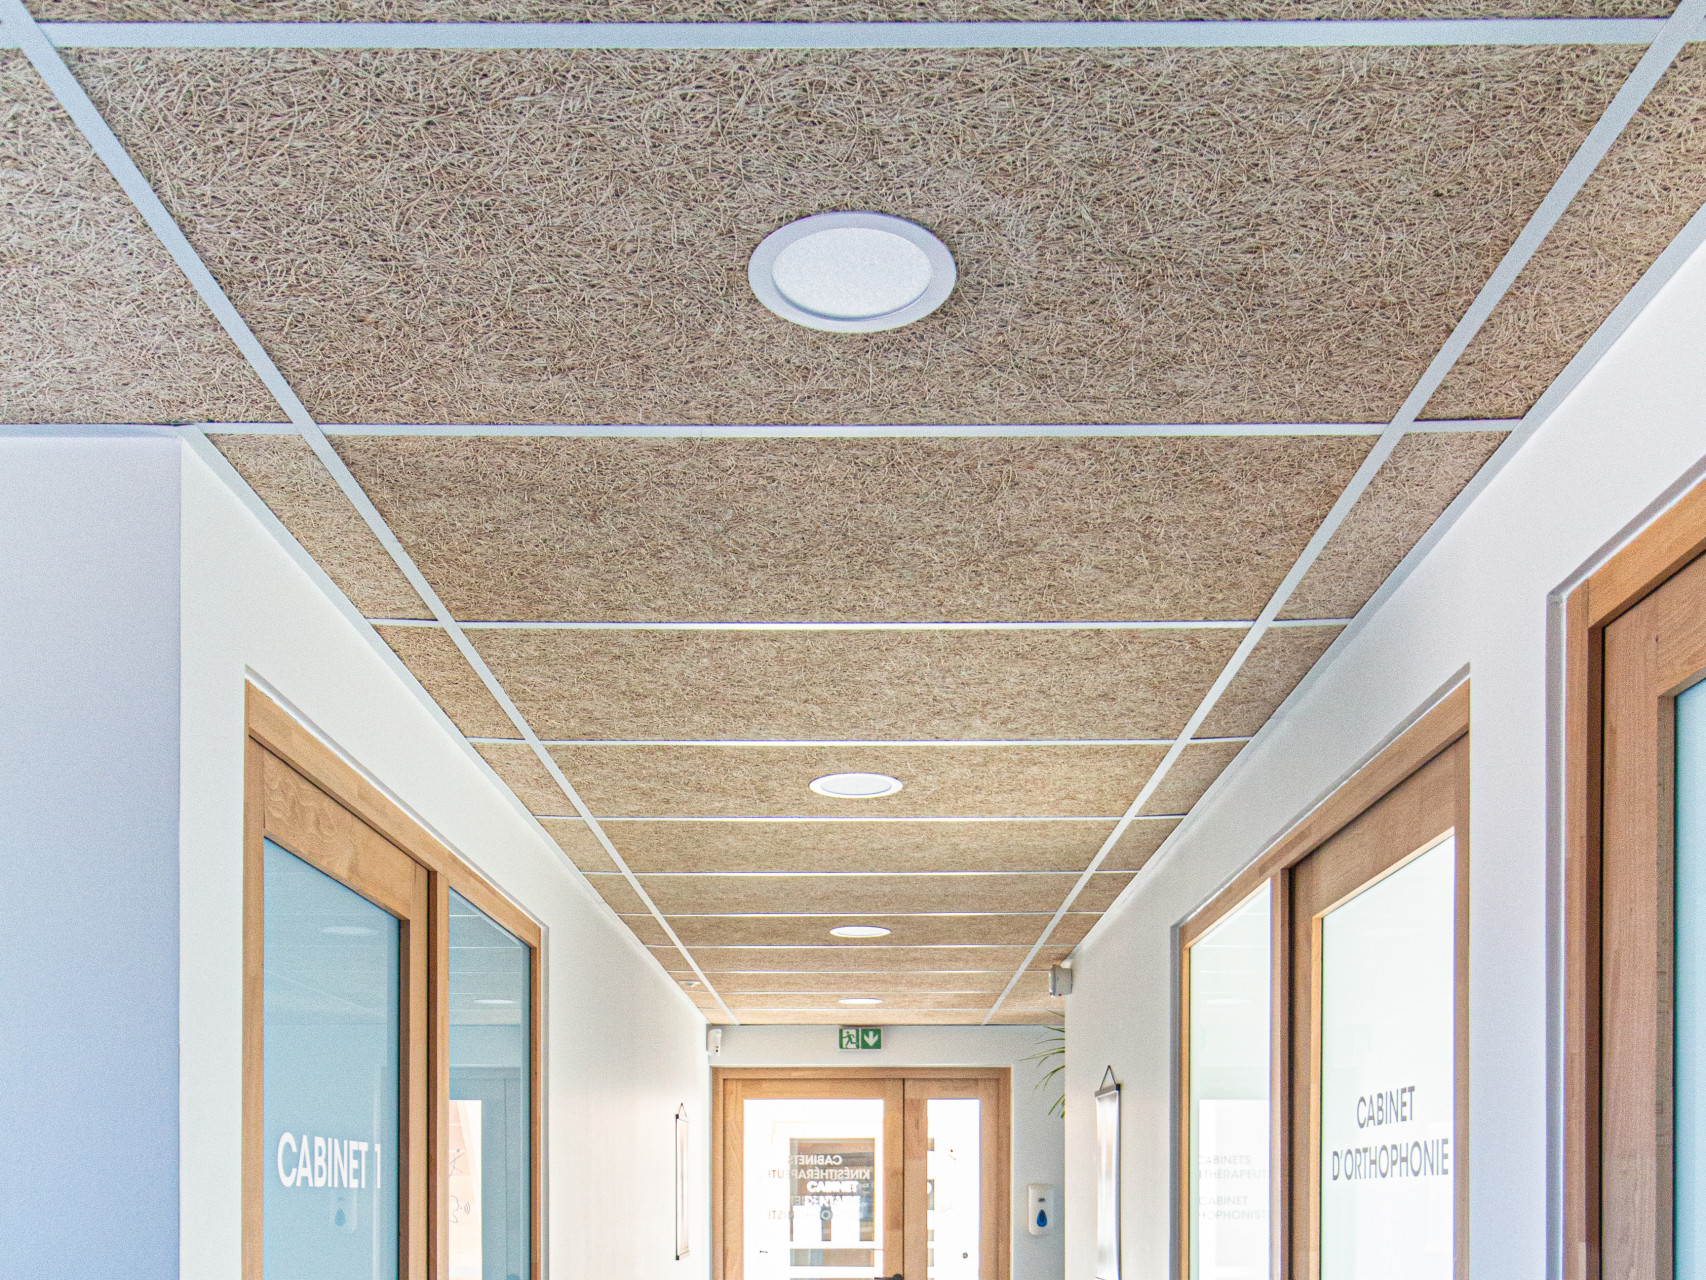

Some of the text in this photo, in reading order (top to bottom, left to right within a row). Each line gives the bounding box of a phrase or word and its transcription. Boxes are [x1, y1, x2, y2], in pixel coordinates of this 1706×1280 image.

[1356, 1085, 1416, 1129] CABINET
[277, 1131, 381, 1189] CABINET 1
[1332, 1138, 1449, 1181] D'ORTHOPHONIE
